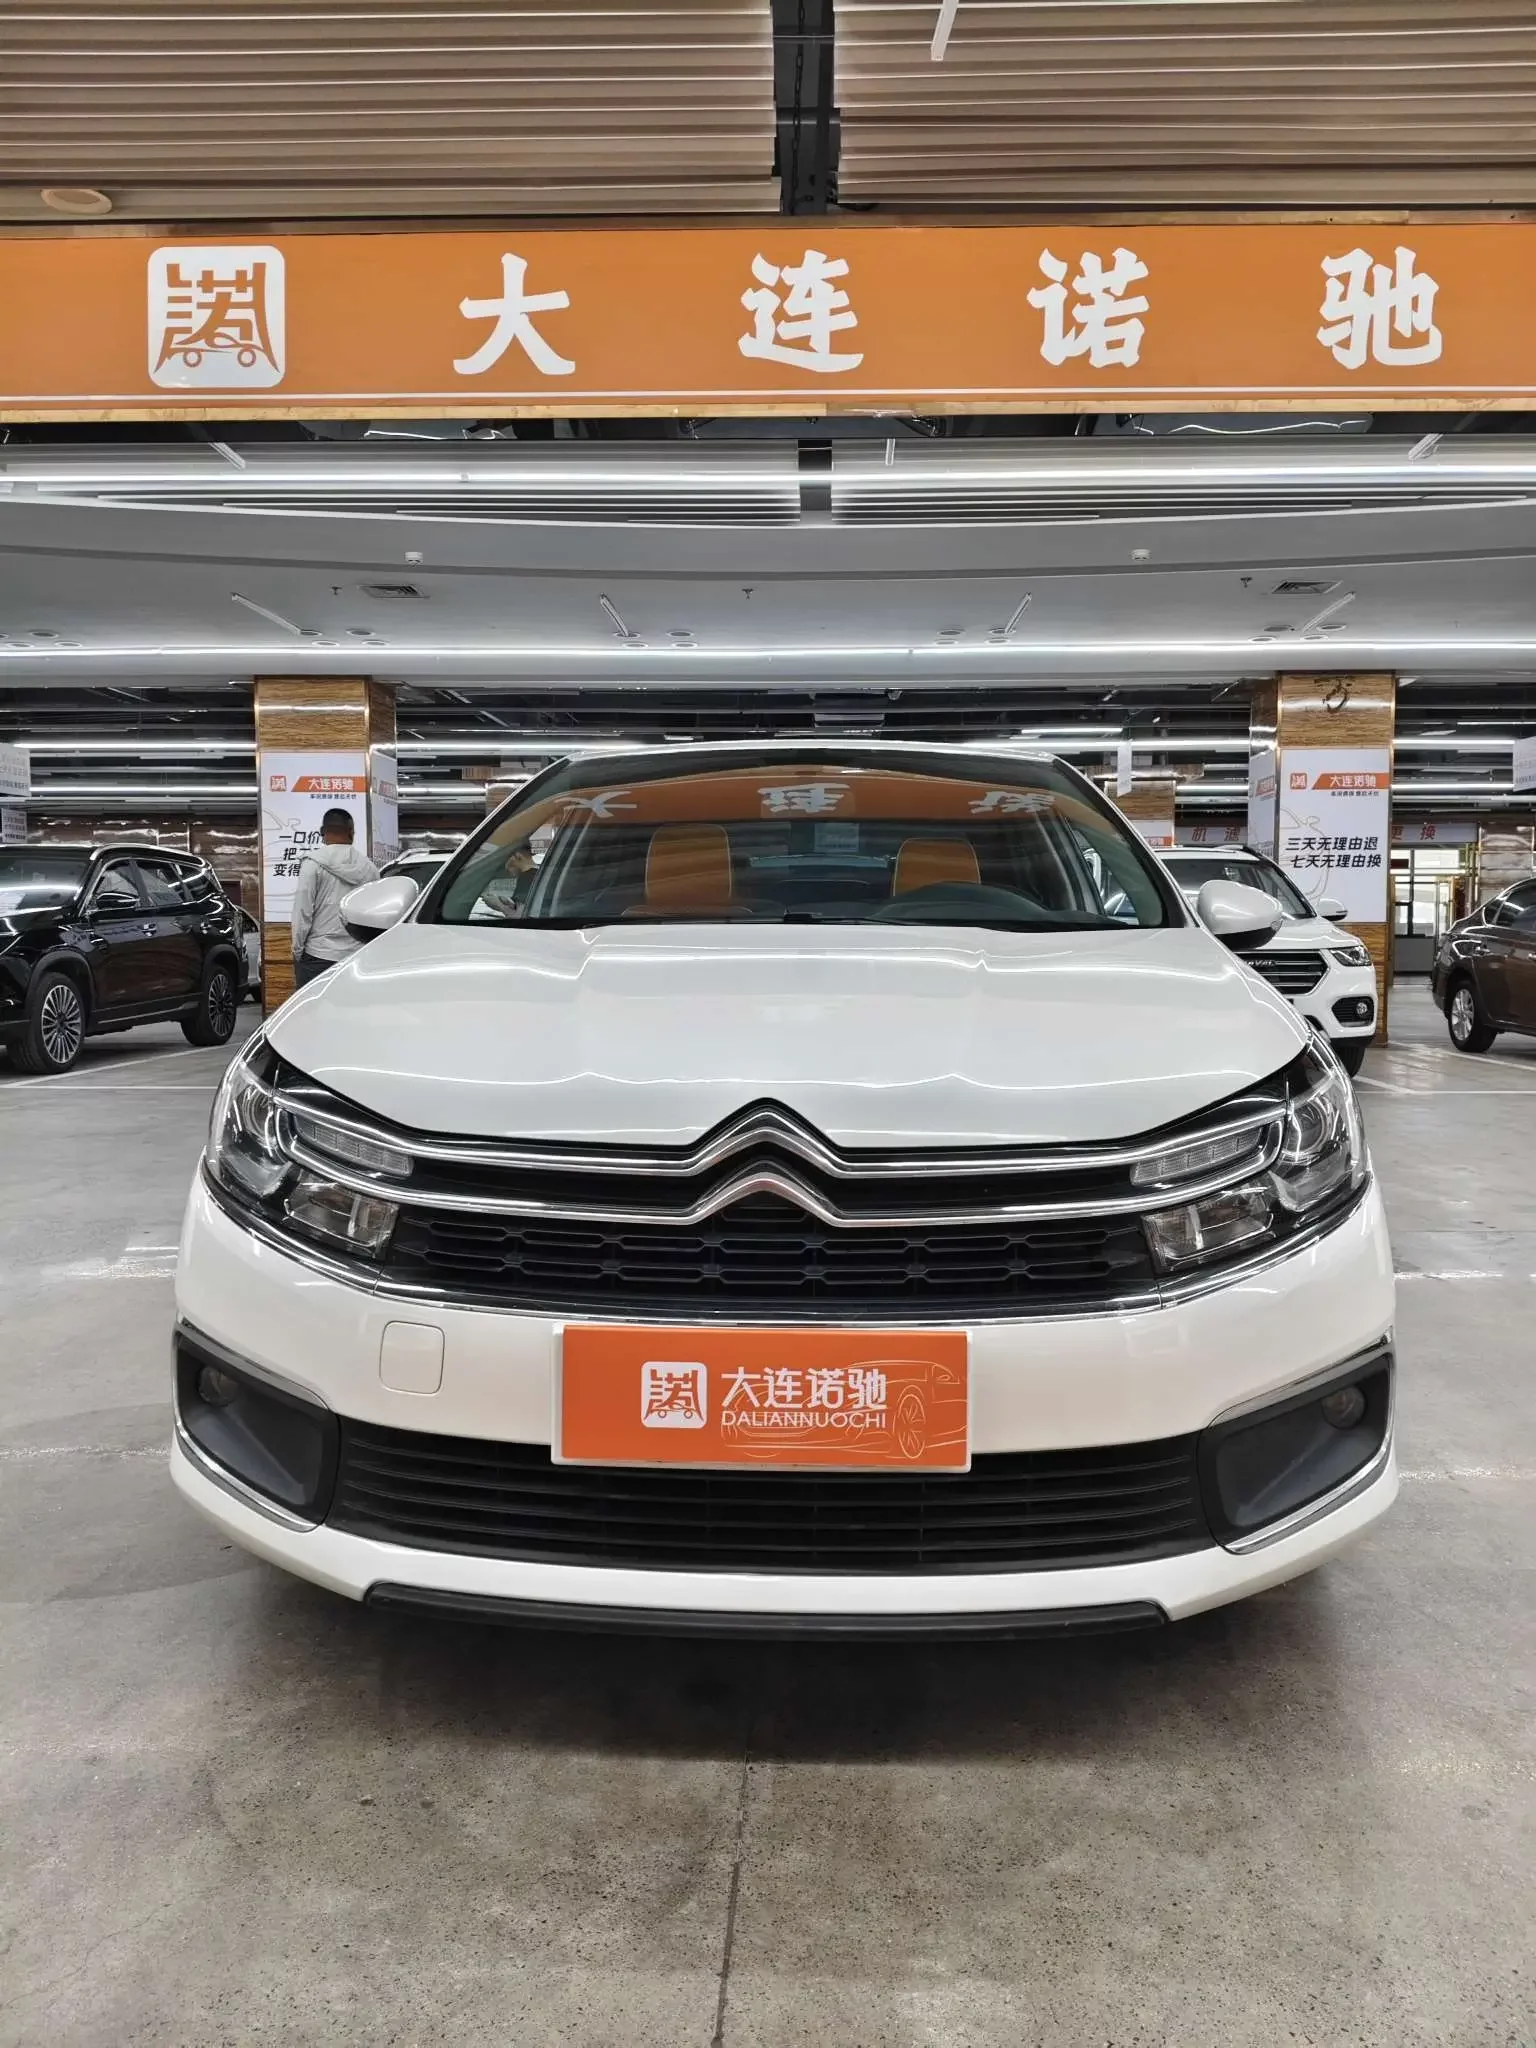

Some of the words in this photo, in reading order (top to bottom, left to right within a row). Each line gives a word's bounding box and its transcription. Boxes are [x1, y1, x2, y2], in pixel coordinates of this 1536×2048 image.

[452, 247, 1443, 376] 大连诺驰
[279, 831, 327, 844] 一口价
[1285, 836, 1379, 851] 三天无理由退
[1291, 854, 1382, 868] 七天无理由换
[720, 1365, 888, 1410] 大连诺驰
[721, 1410, 887, 1429] DALIANNUOCHI
